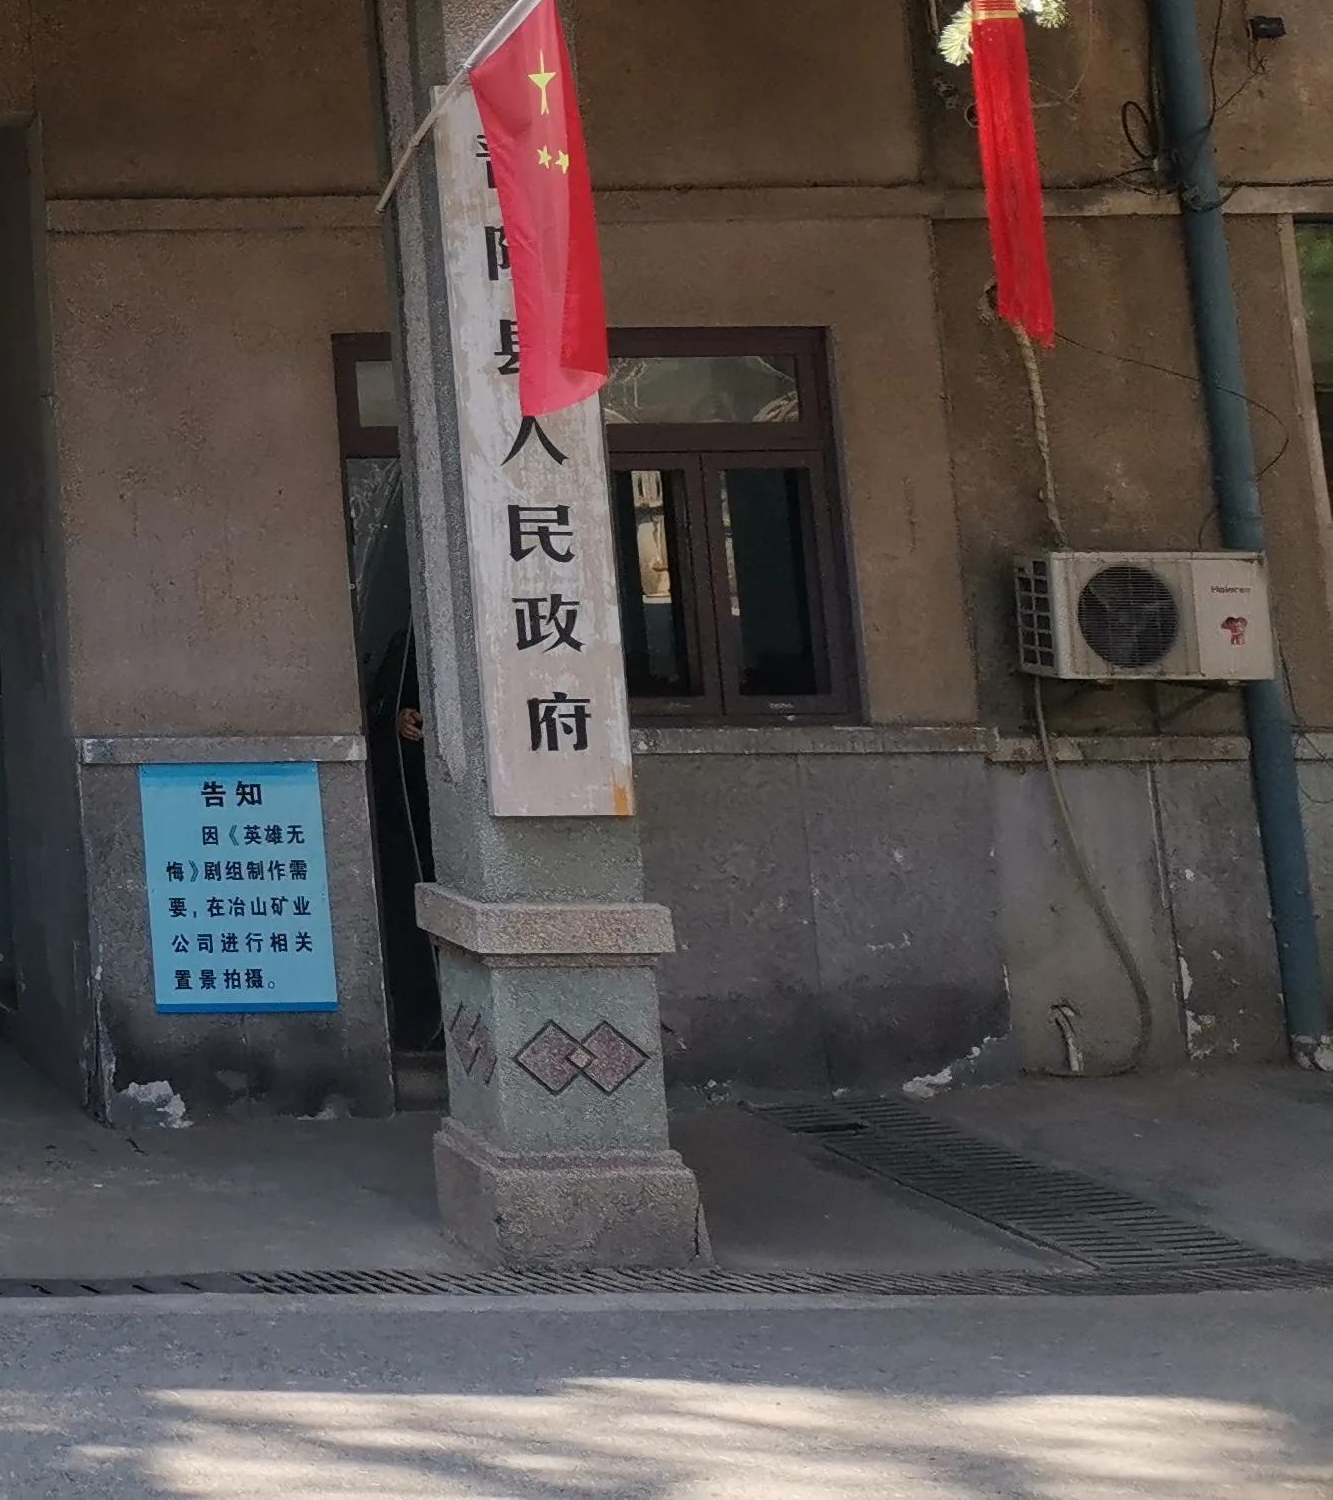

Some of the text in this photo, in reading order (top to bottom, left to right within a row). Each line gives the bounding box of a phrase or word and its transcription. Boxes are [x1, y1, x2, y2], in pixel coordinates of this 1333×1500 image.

[474, 134, 592, 753] 人民政府
[201, 781, 263, 808] 告知
[202, 825, 306, 846] 因《英雄无
[166, 859, 308, 882] 悔》剧组制作需
[169, 896, 312, 918] 要，在冶山矿业
[171, 932, 313, 954] 公司进行相关
[174, 968, 276, 991] 置景拍摄。
